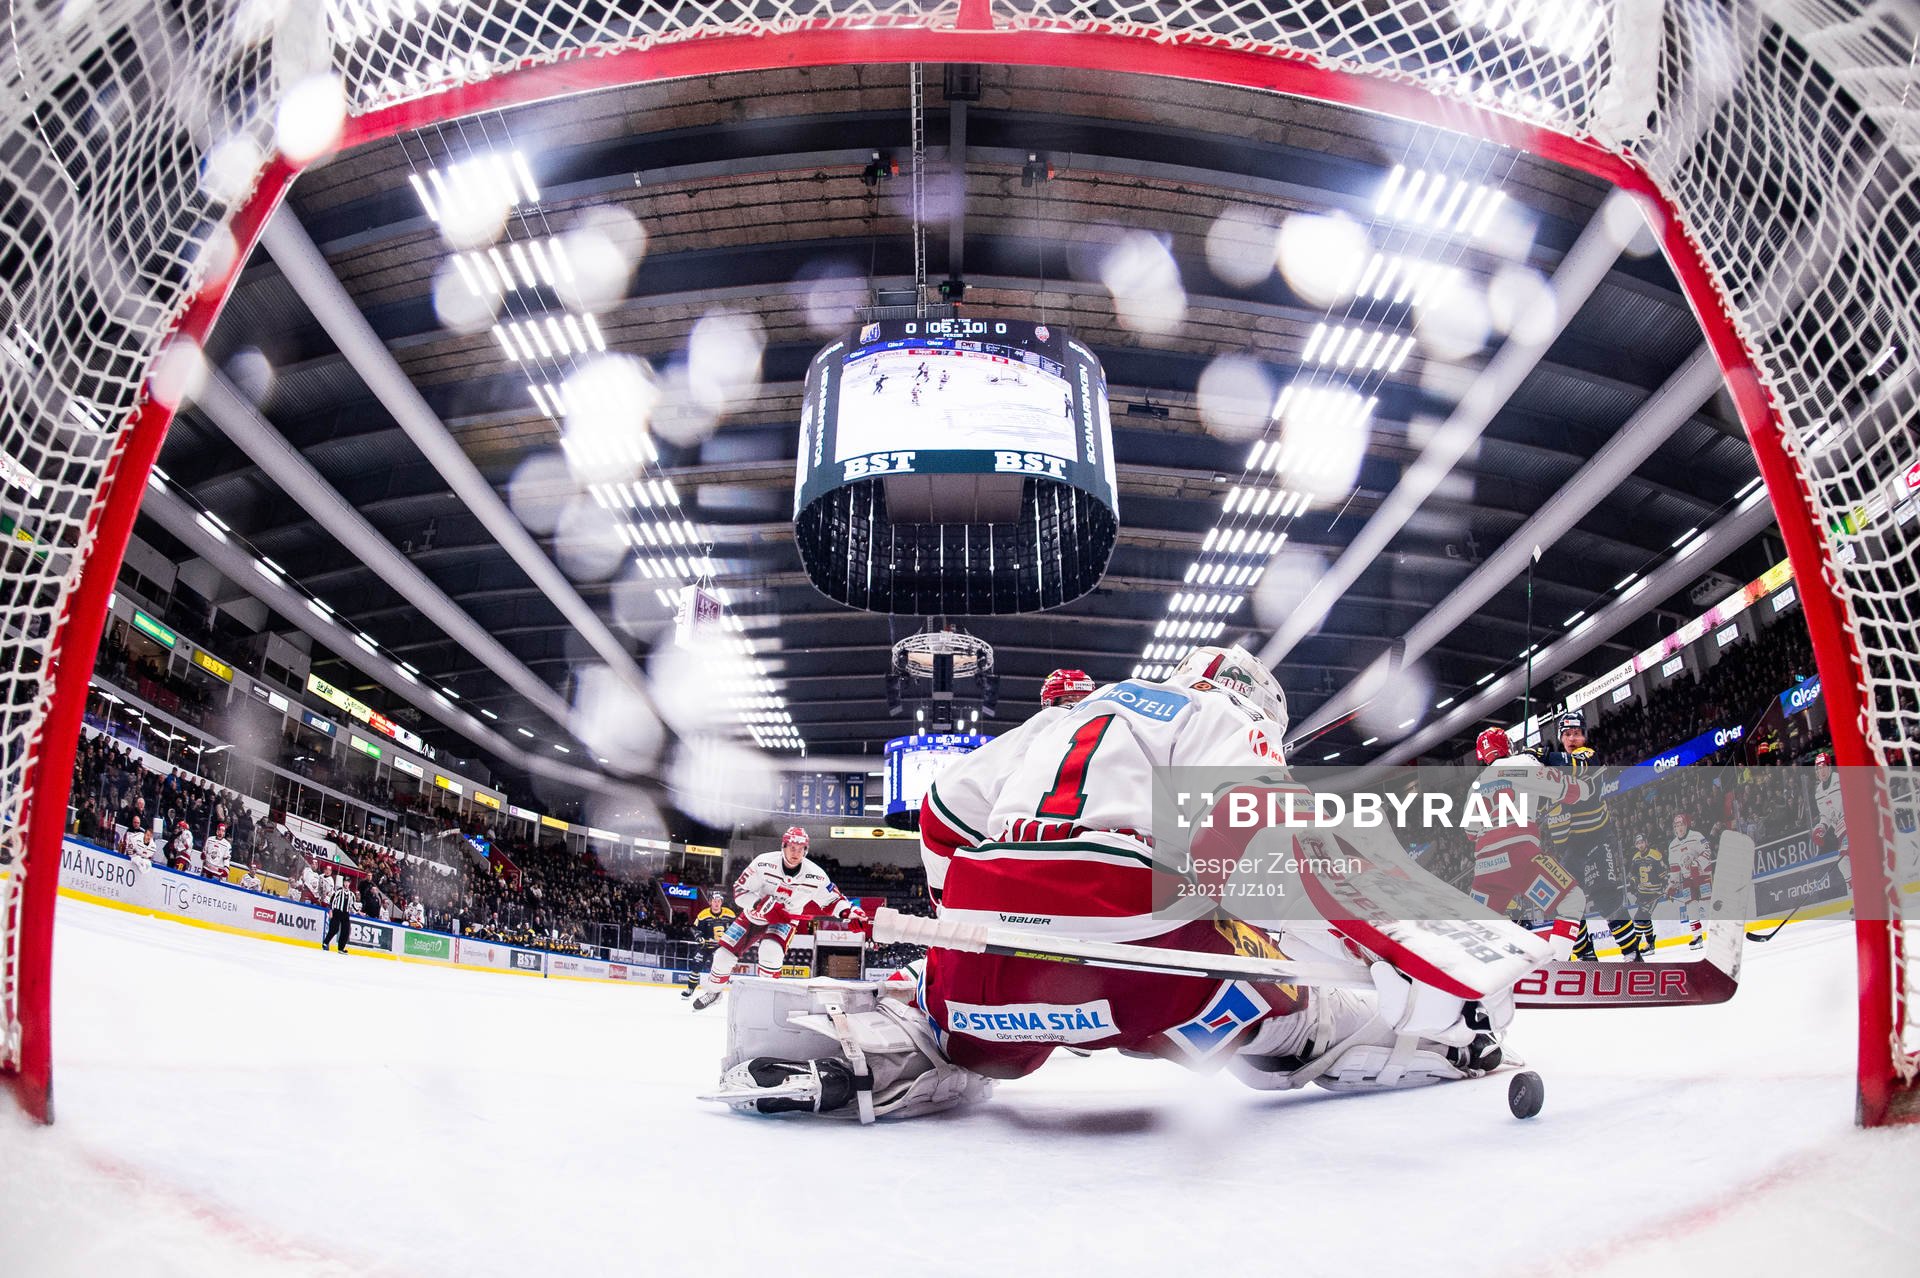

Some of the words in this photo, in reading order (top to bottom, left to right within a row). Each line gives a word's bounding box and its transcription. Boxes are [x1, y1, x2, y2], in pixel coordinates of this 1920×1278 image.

[905, 322, 917, 334] 0
[995, 322, 1007, 334] 0
[844, 451, 915, 475] BST
[994, 451, 1066, 476] BST
[1105, 688, 1174, 719] HOTELL
[1036, 712, 1116, 819] 1
[293, 836, 329, 858] SCANIA
[1752, 840, 1819, 875] ÅNSBRO
[60, 849, 136, 887] MÅNSBRO
[1535, 855, 1570, 885] Malux
[668, 886, 691, 897] Qlosr
[1787, 872, 1830, 898] randstad
[276, 912, 295, 927] ALL
[350, 924, 384, 945] BST
[517, 954, 536, 967] BST
[969, 1012, 1047, 1030] STENA
[1047, 1007, 1109, 1030] STÅL
